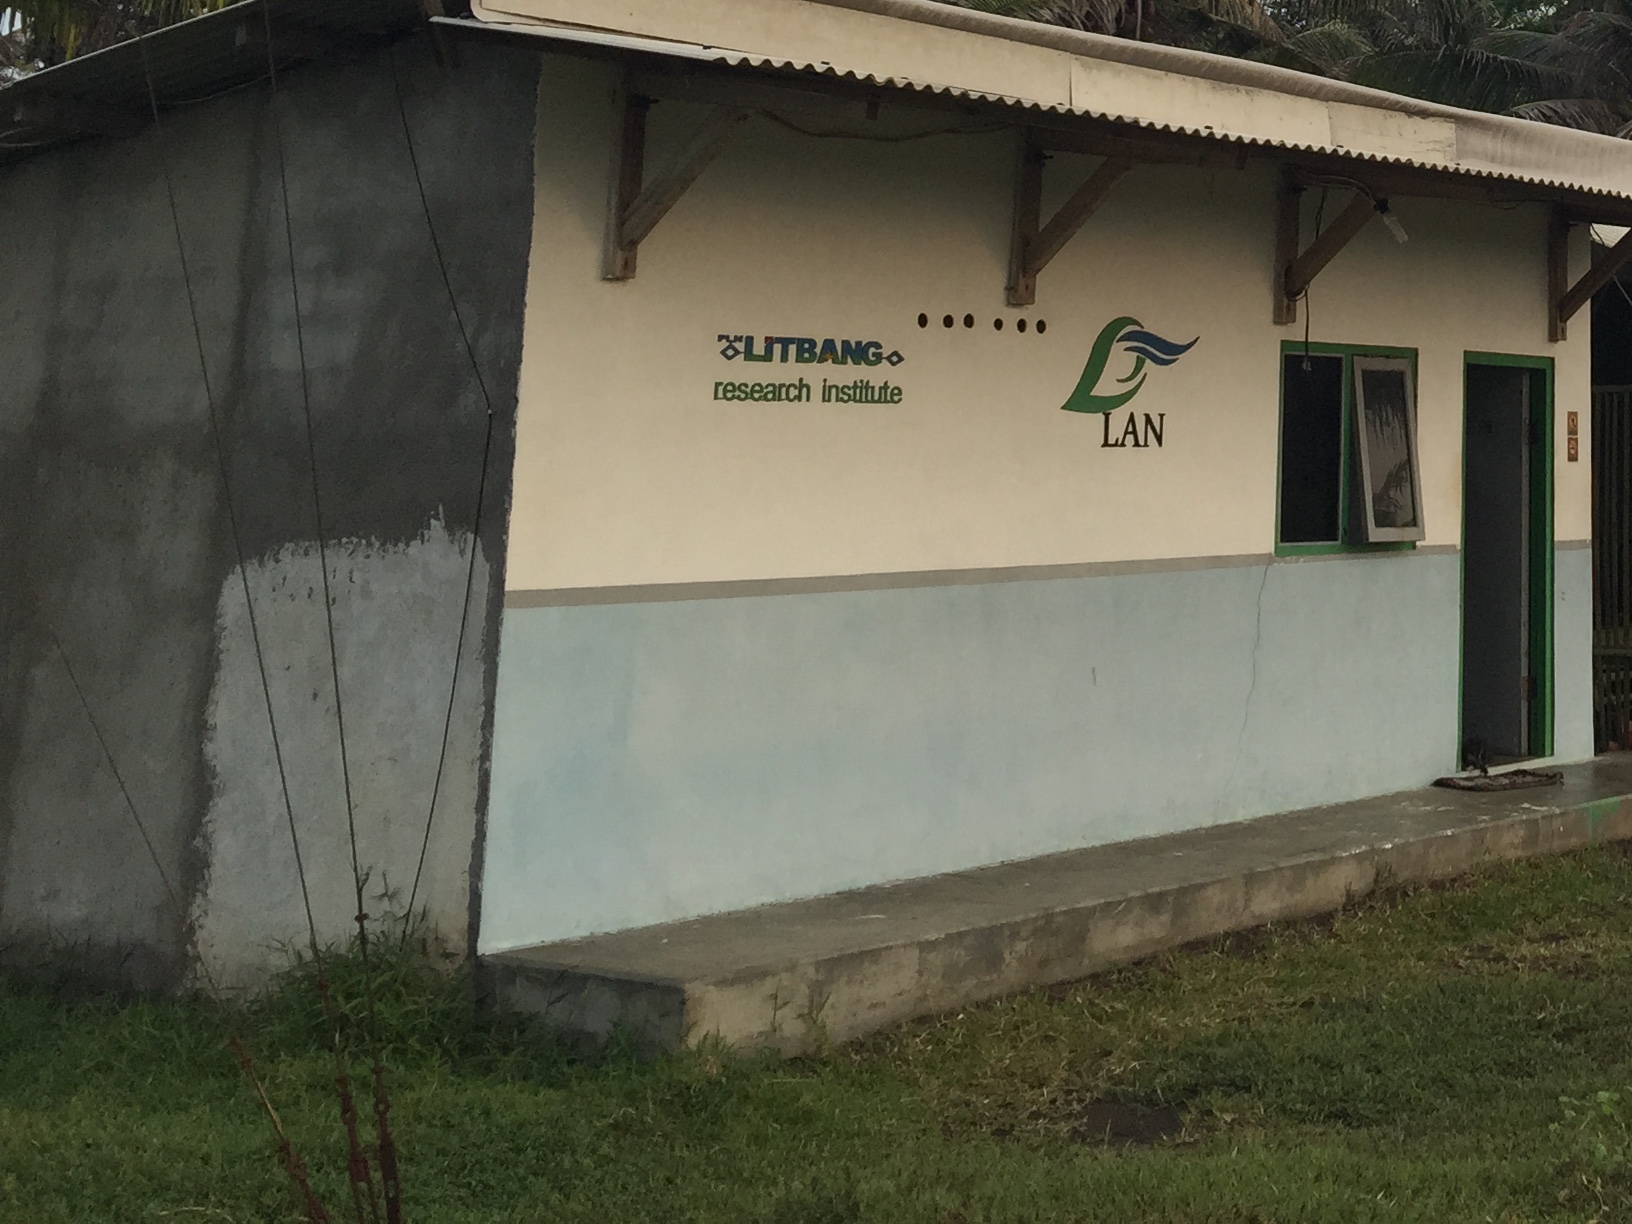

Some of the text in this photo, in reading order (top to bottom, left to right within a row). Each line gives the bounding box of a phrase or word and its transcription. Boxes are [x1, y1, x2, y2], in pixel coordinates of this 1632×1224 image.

[713, 377, 903, 404] research institute
[1101, 411, 1166, 448] LAN
